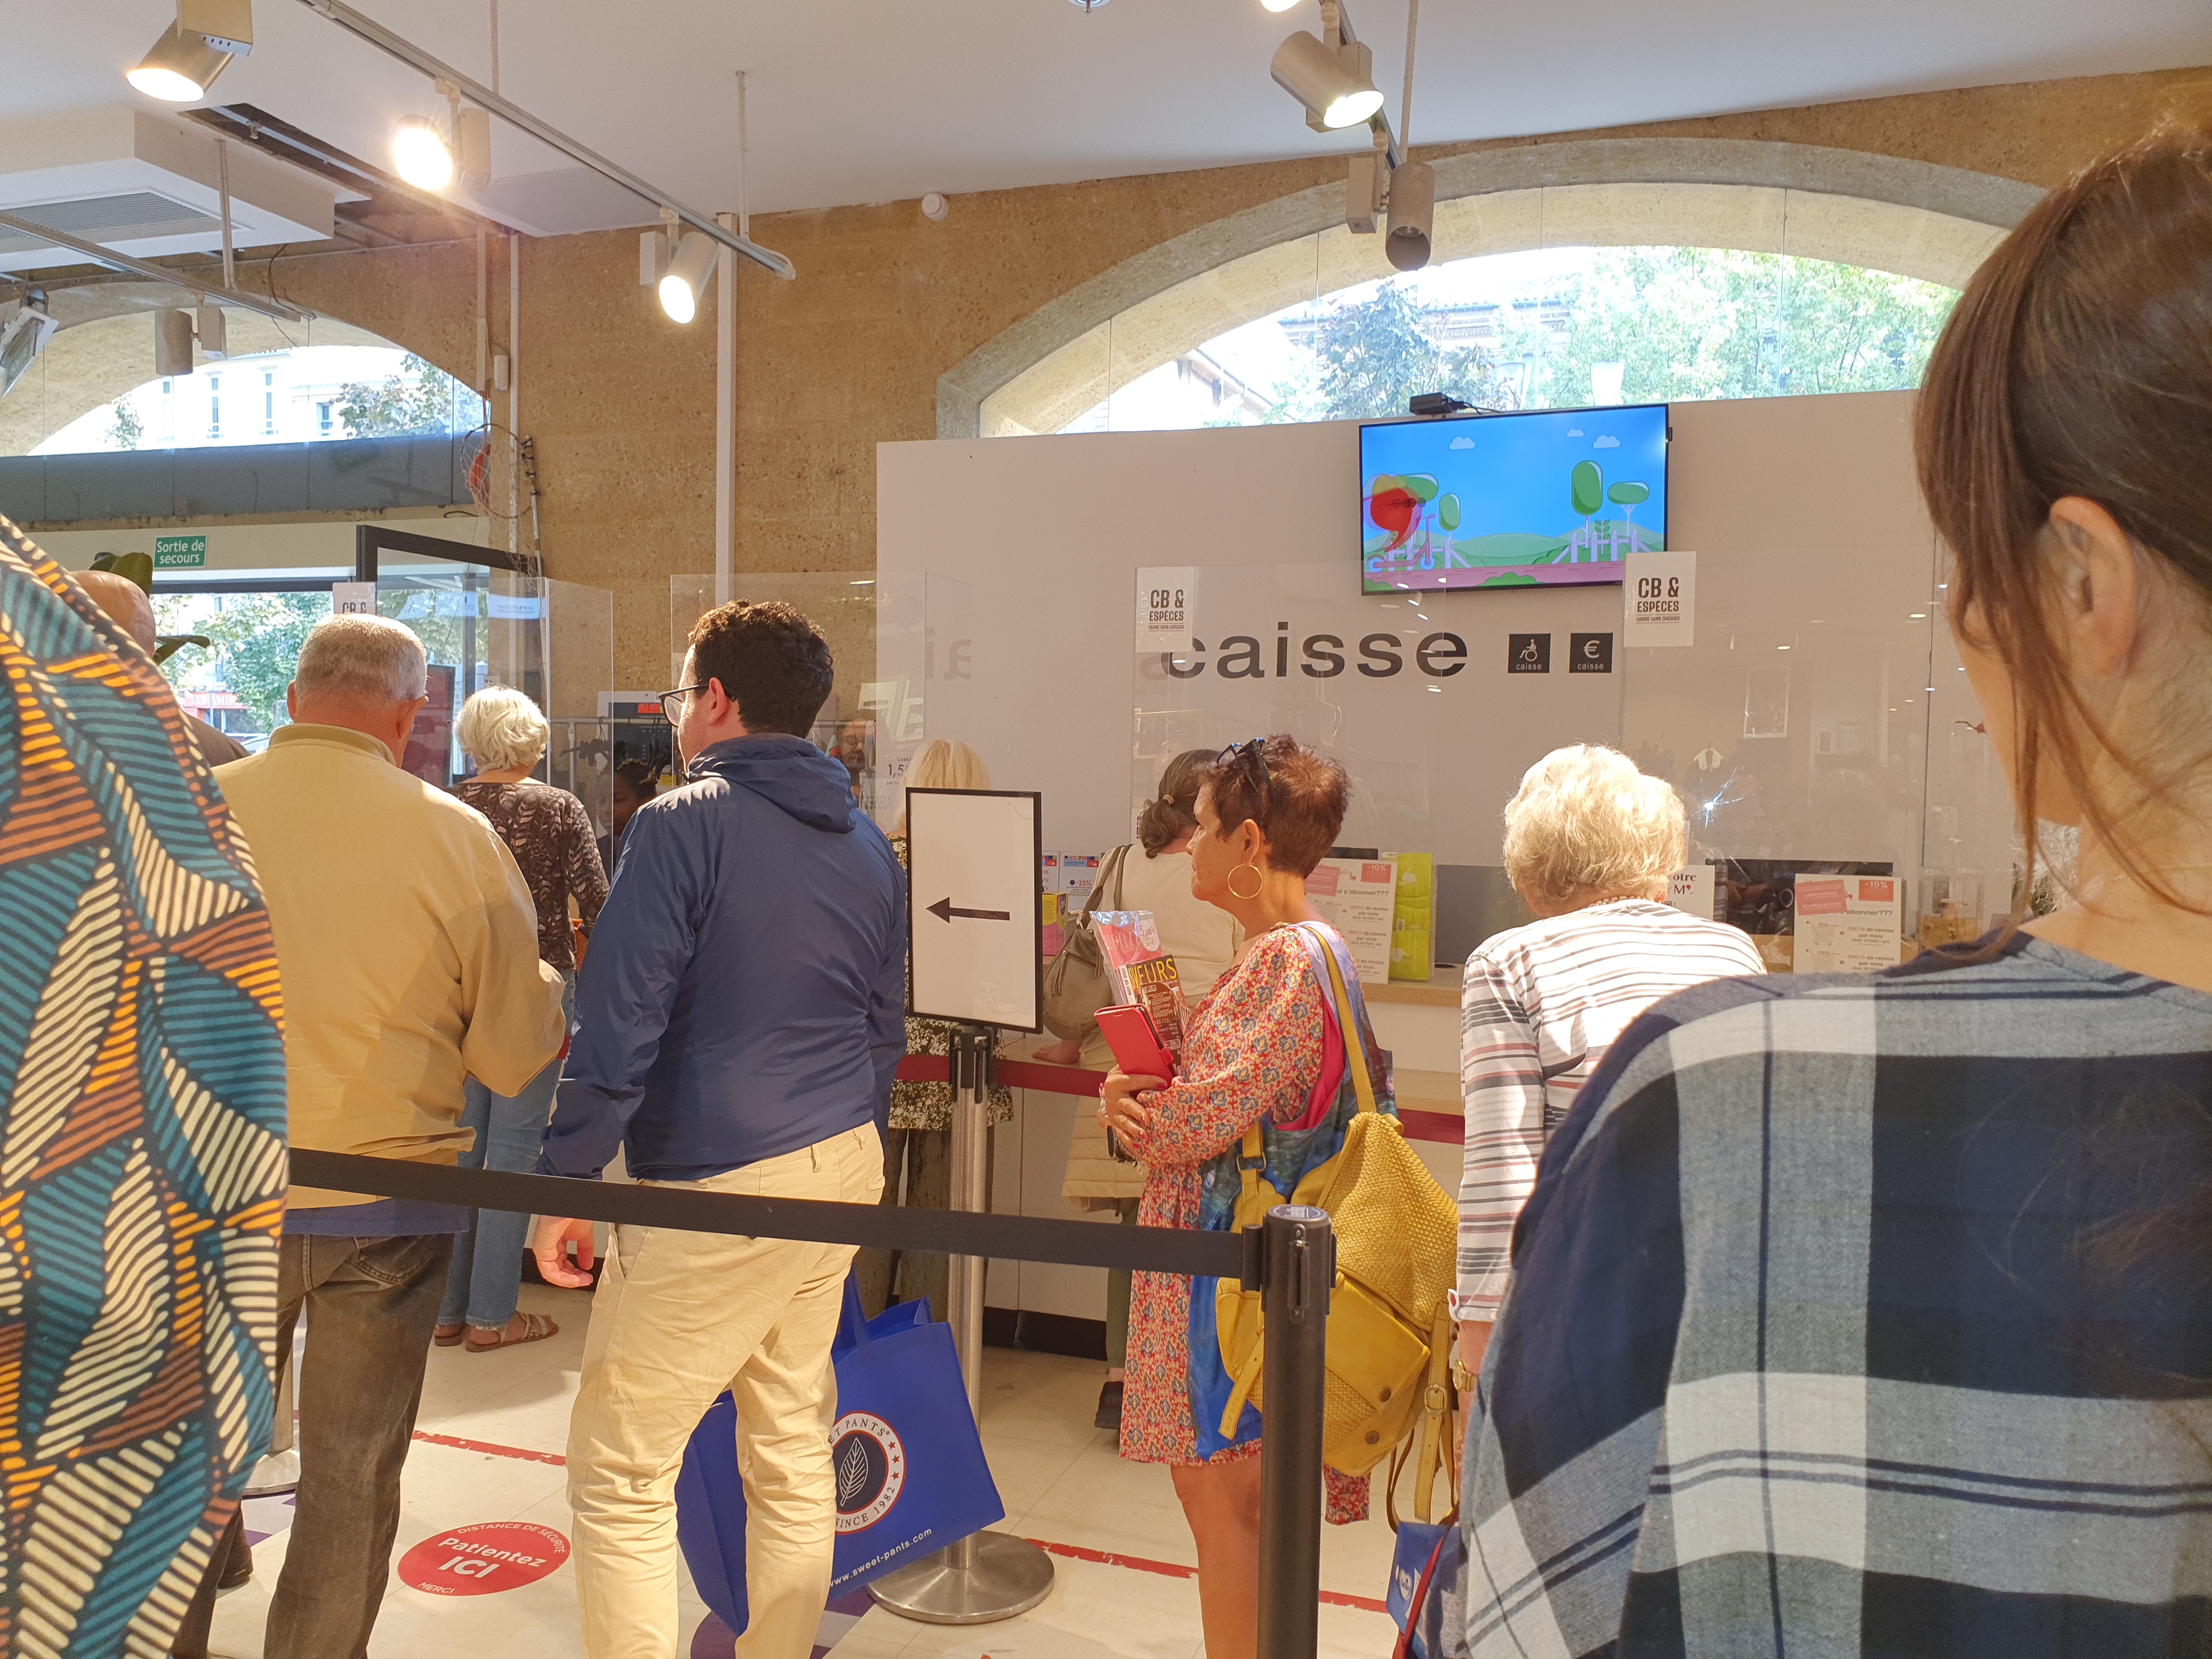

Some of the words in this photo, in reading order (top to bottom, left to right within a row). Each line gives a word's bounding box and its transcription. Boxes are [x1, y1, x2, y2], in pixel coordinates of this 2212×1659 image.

[156, 540, 188, 553] Sortie
[191, 539, 205, 551] de
[159, 553, 200, 565] secours
[1638, 577, 1662, 598] CB
[1668, 577, 1679, 597] &
[1150, 589, 1170, 608] CB
[1174, 589, 1184, 608] &
[1161, 621, 1468, 679] caisse
[1516, 662, 1542, 670] caisse
[1577, 662, 1604, 670] caisse
[888, 764, 909, 778] 1,5
[1673, 873, 1696, 882] otre
[836, 1513, 869, 1528] SINCE
[873, 1487, 895, 1514] 1982
[457, 1523, 522, 1534] DISTANCE
[437, 1537, 548, 1567] Patientez
[438, 1556, 500, 1579] ICI
[417, 1582, 455, 1594] MERCI
